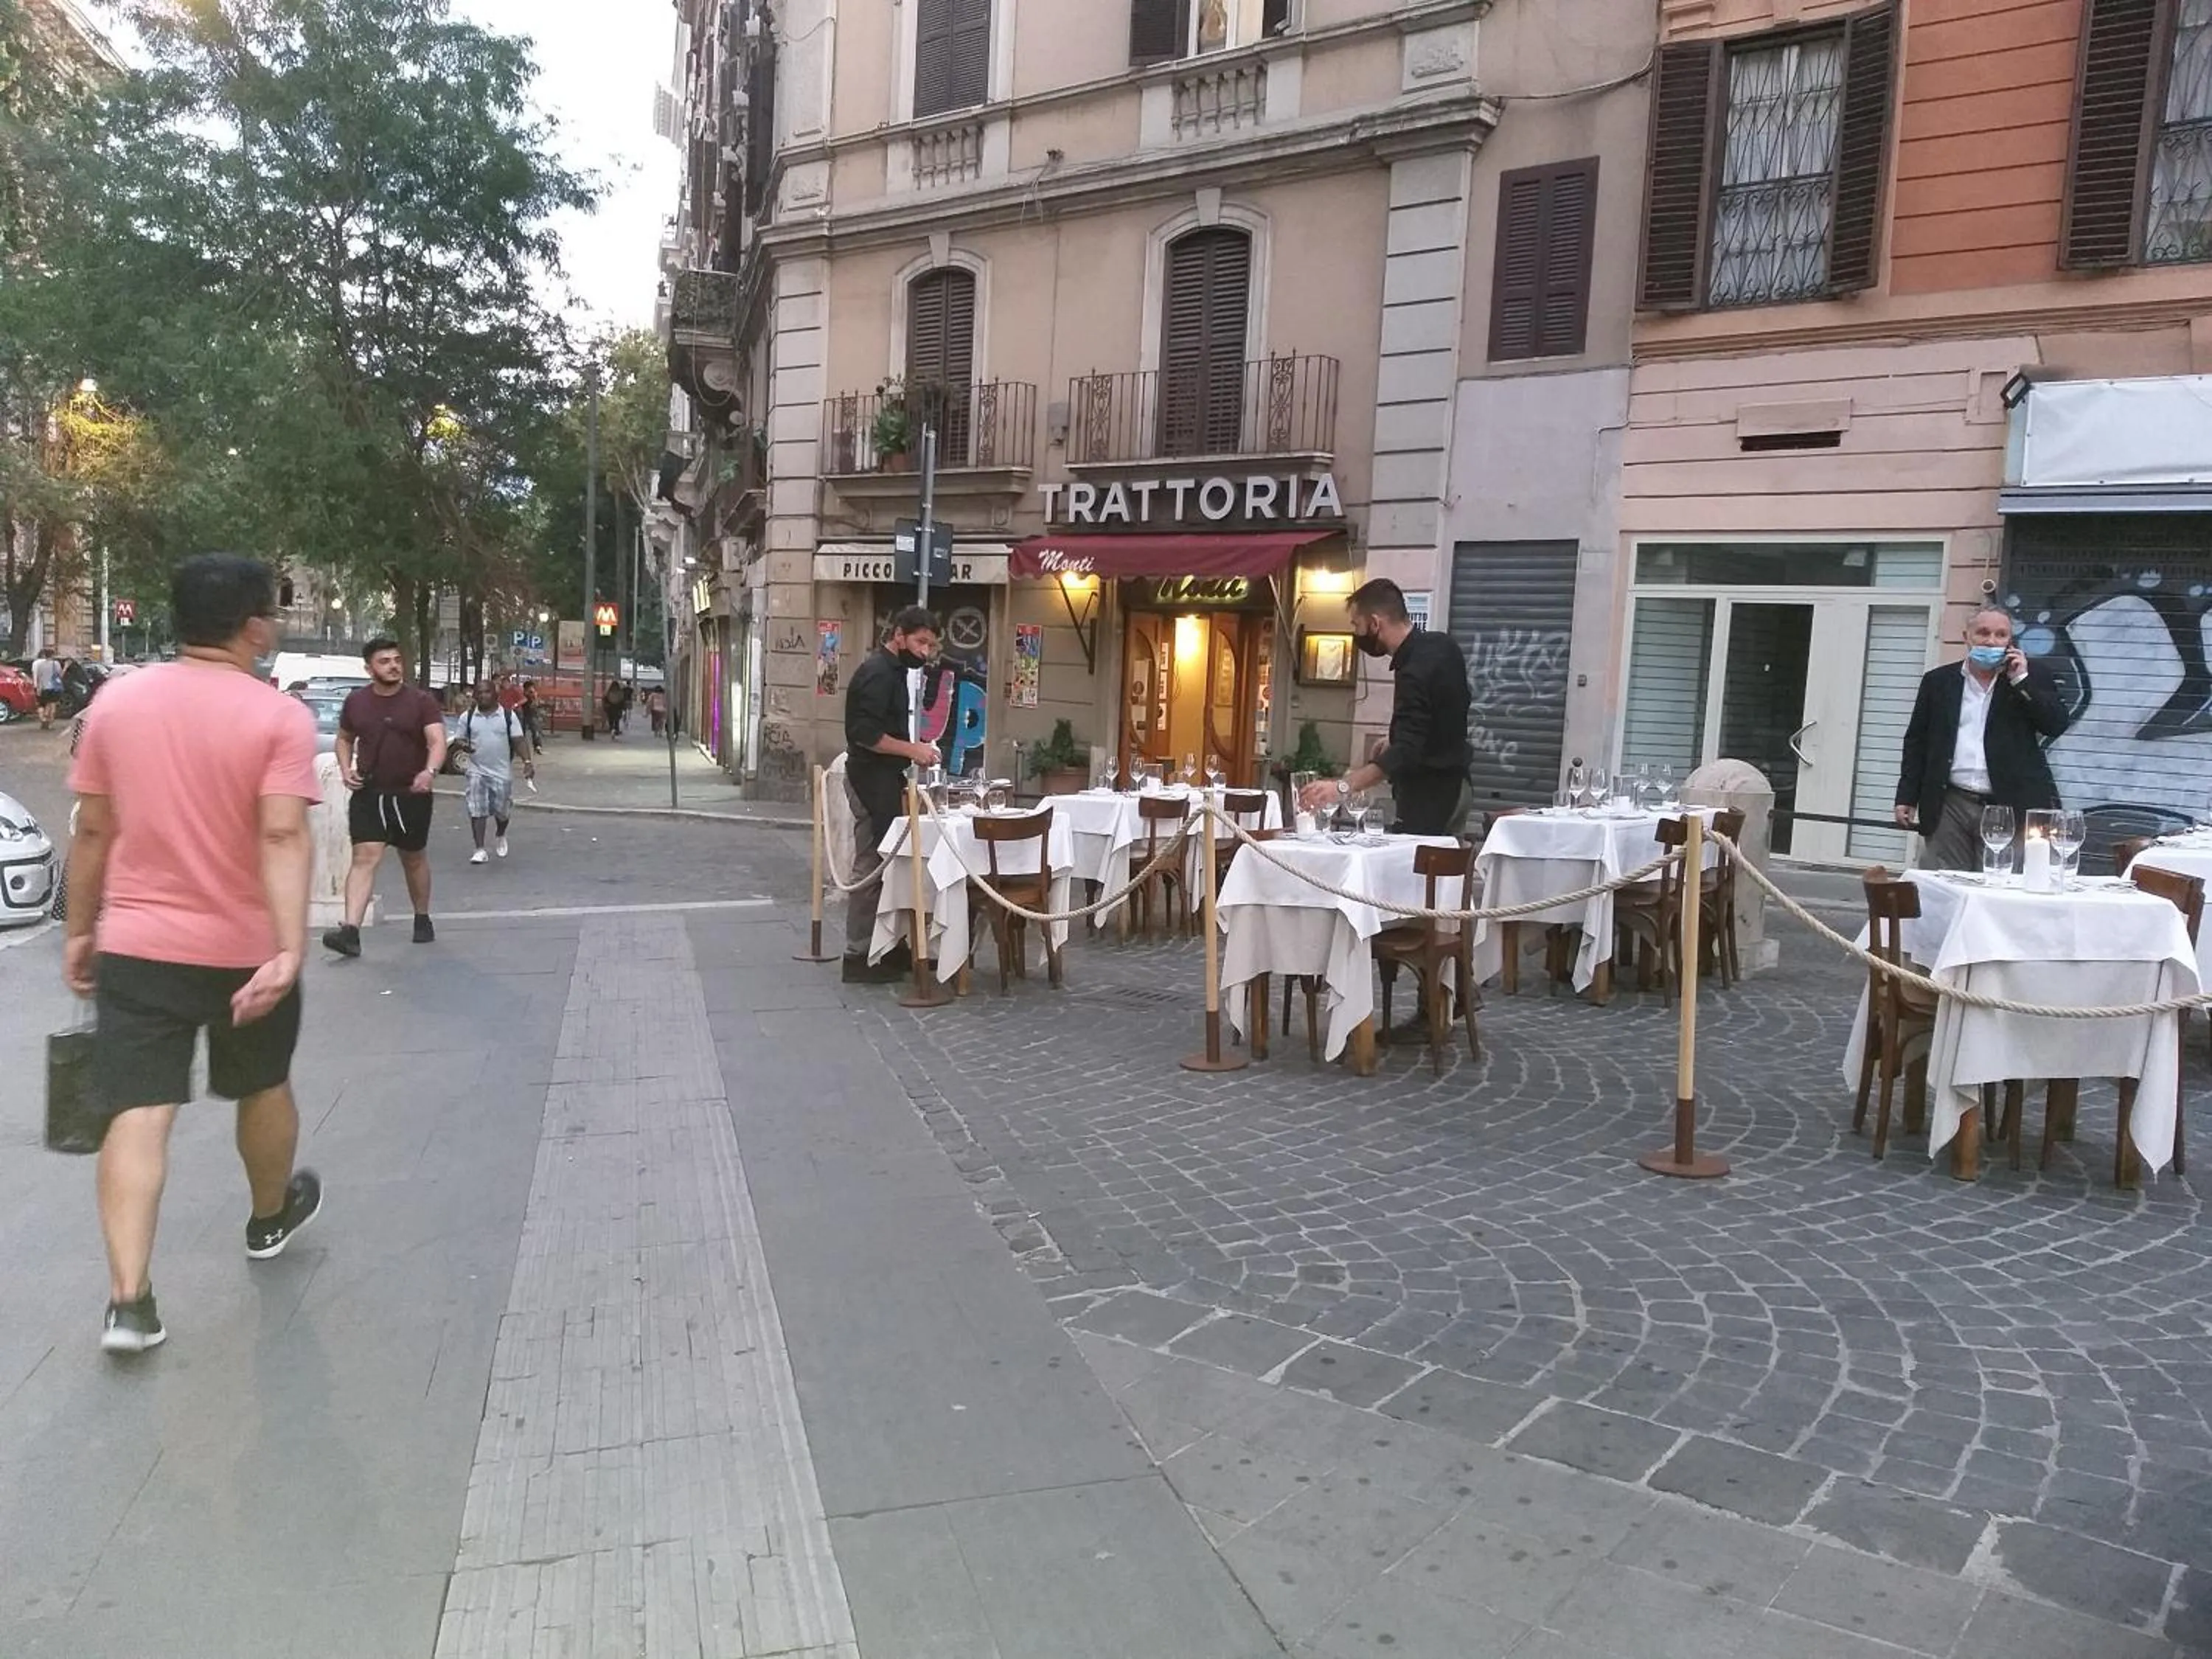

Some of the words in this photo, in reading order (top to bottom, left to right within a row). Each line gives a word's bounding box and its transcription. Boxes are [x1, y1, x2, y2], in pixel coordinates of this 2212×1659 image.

[1037, 473, 1343, 523] TRATTORIA
[1037, 549, 1095, 571] Monti
[843, 563, 892, 579] PICCO
[950, 564, 973, 580] AR
[513, 630, 524, 645] P
[532, 636, 541, 648] P
